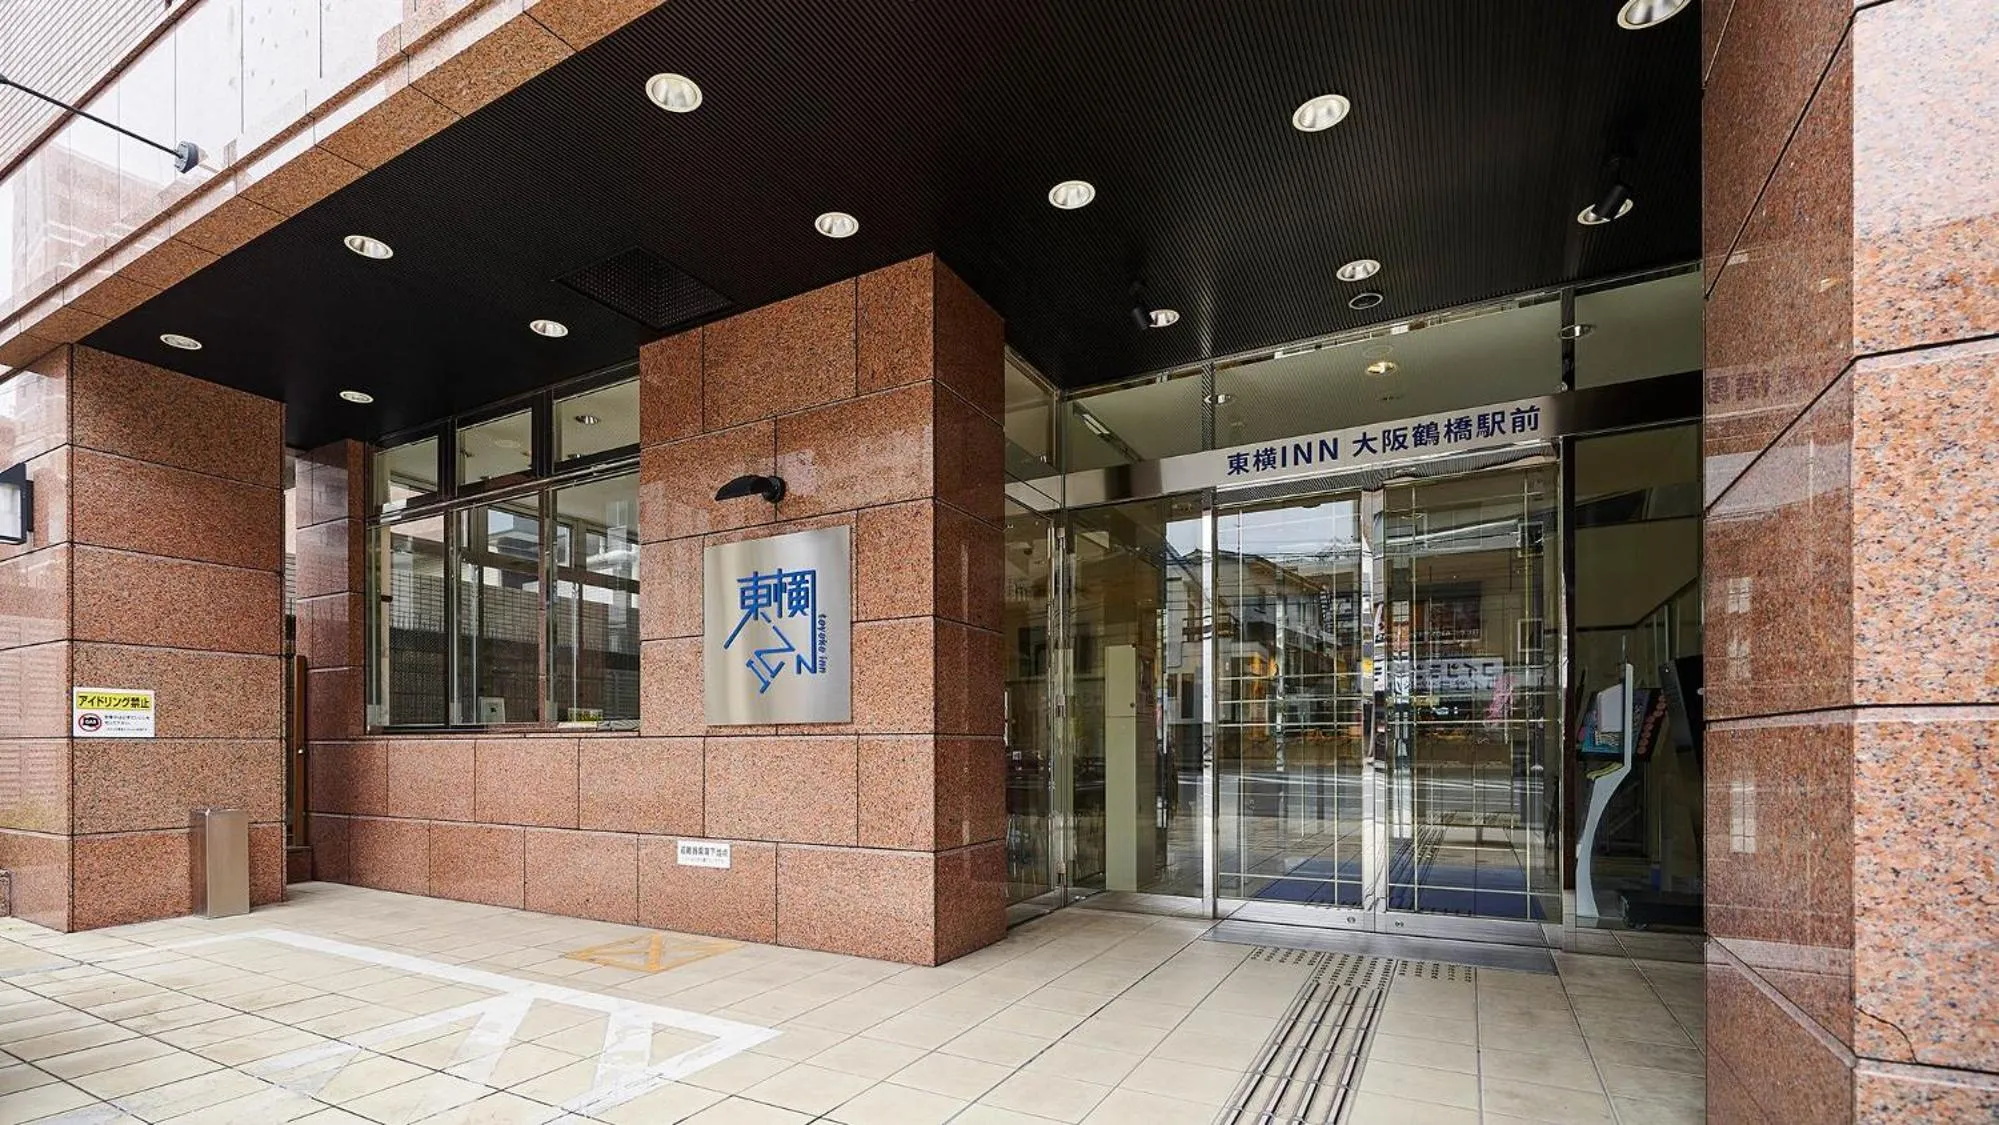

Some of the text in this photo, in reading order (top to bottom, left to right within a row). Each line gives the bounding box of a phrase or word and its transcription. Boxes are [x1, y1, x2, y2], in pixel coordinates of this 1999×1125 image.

[1226, 404, 1541, 476] 東横INN 大阪鶴橋駅前
[817, 613, 828, 674] toyoko inn
[78, 695, 150, 709] アイドリング禁止
